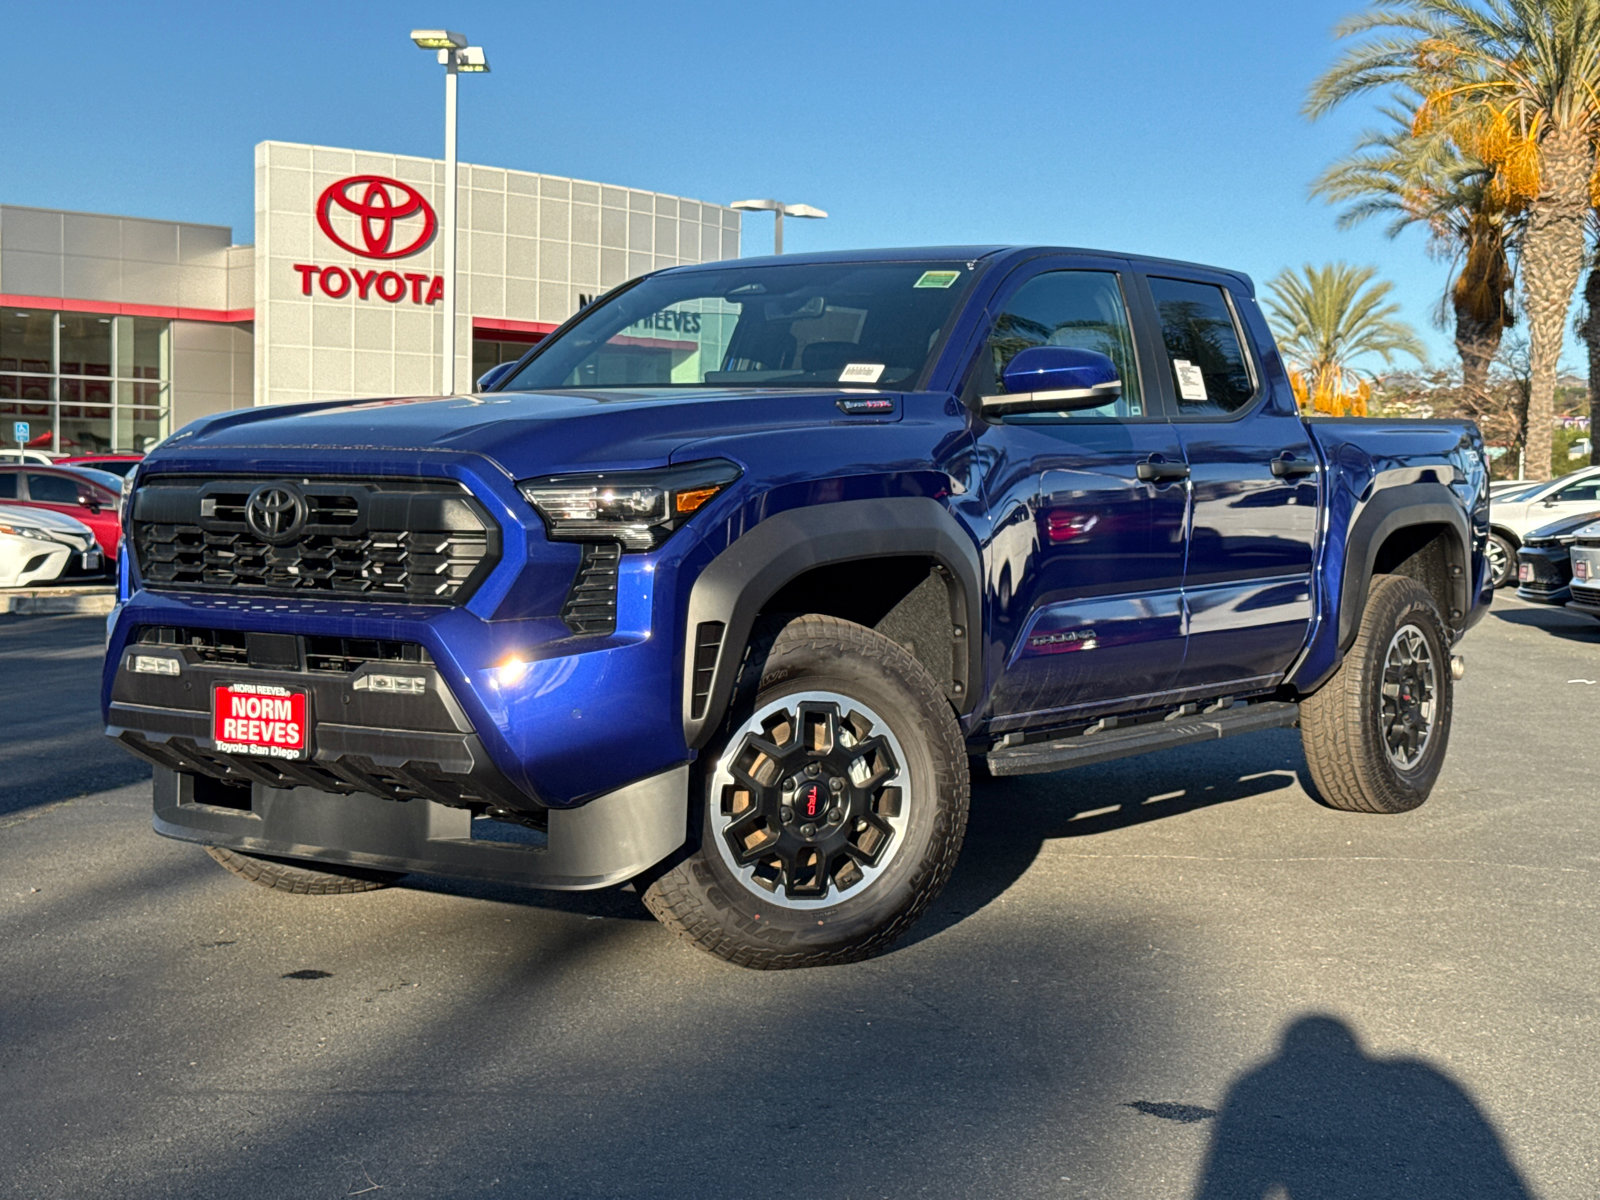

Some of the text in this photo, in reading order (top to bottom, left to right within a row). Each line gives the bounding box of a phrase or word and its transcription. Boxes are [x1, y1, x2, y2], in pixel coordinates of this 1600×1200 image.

[293, 264, 445, 305] TOYOTA
[233, 683, 286, 697] NORM REEVES
[223, 696, 300, 744] NORM REEVES
[215, 740, 300, 760] Toyota San Diego
[807, 785, 817, 815] TRD
